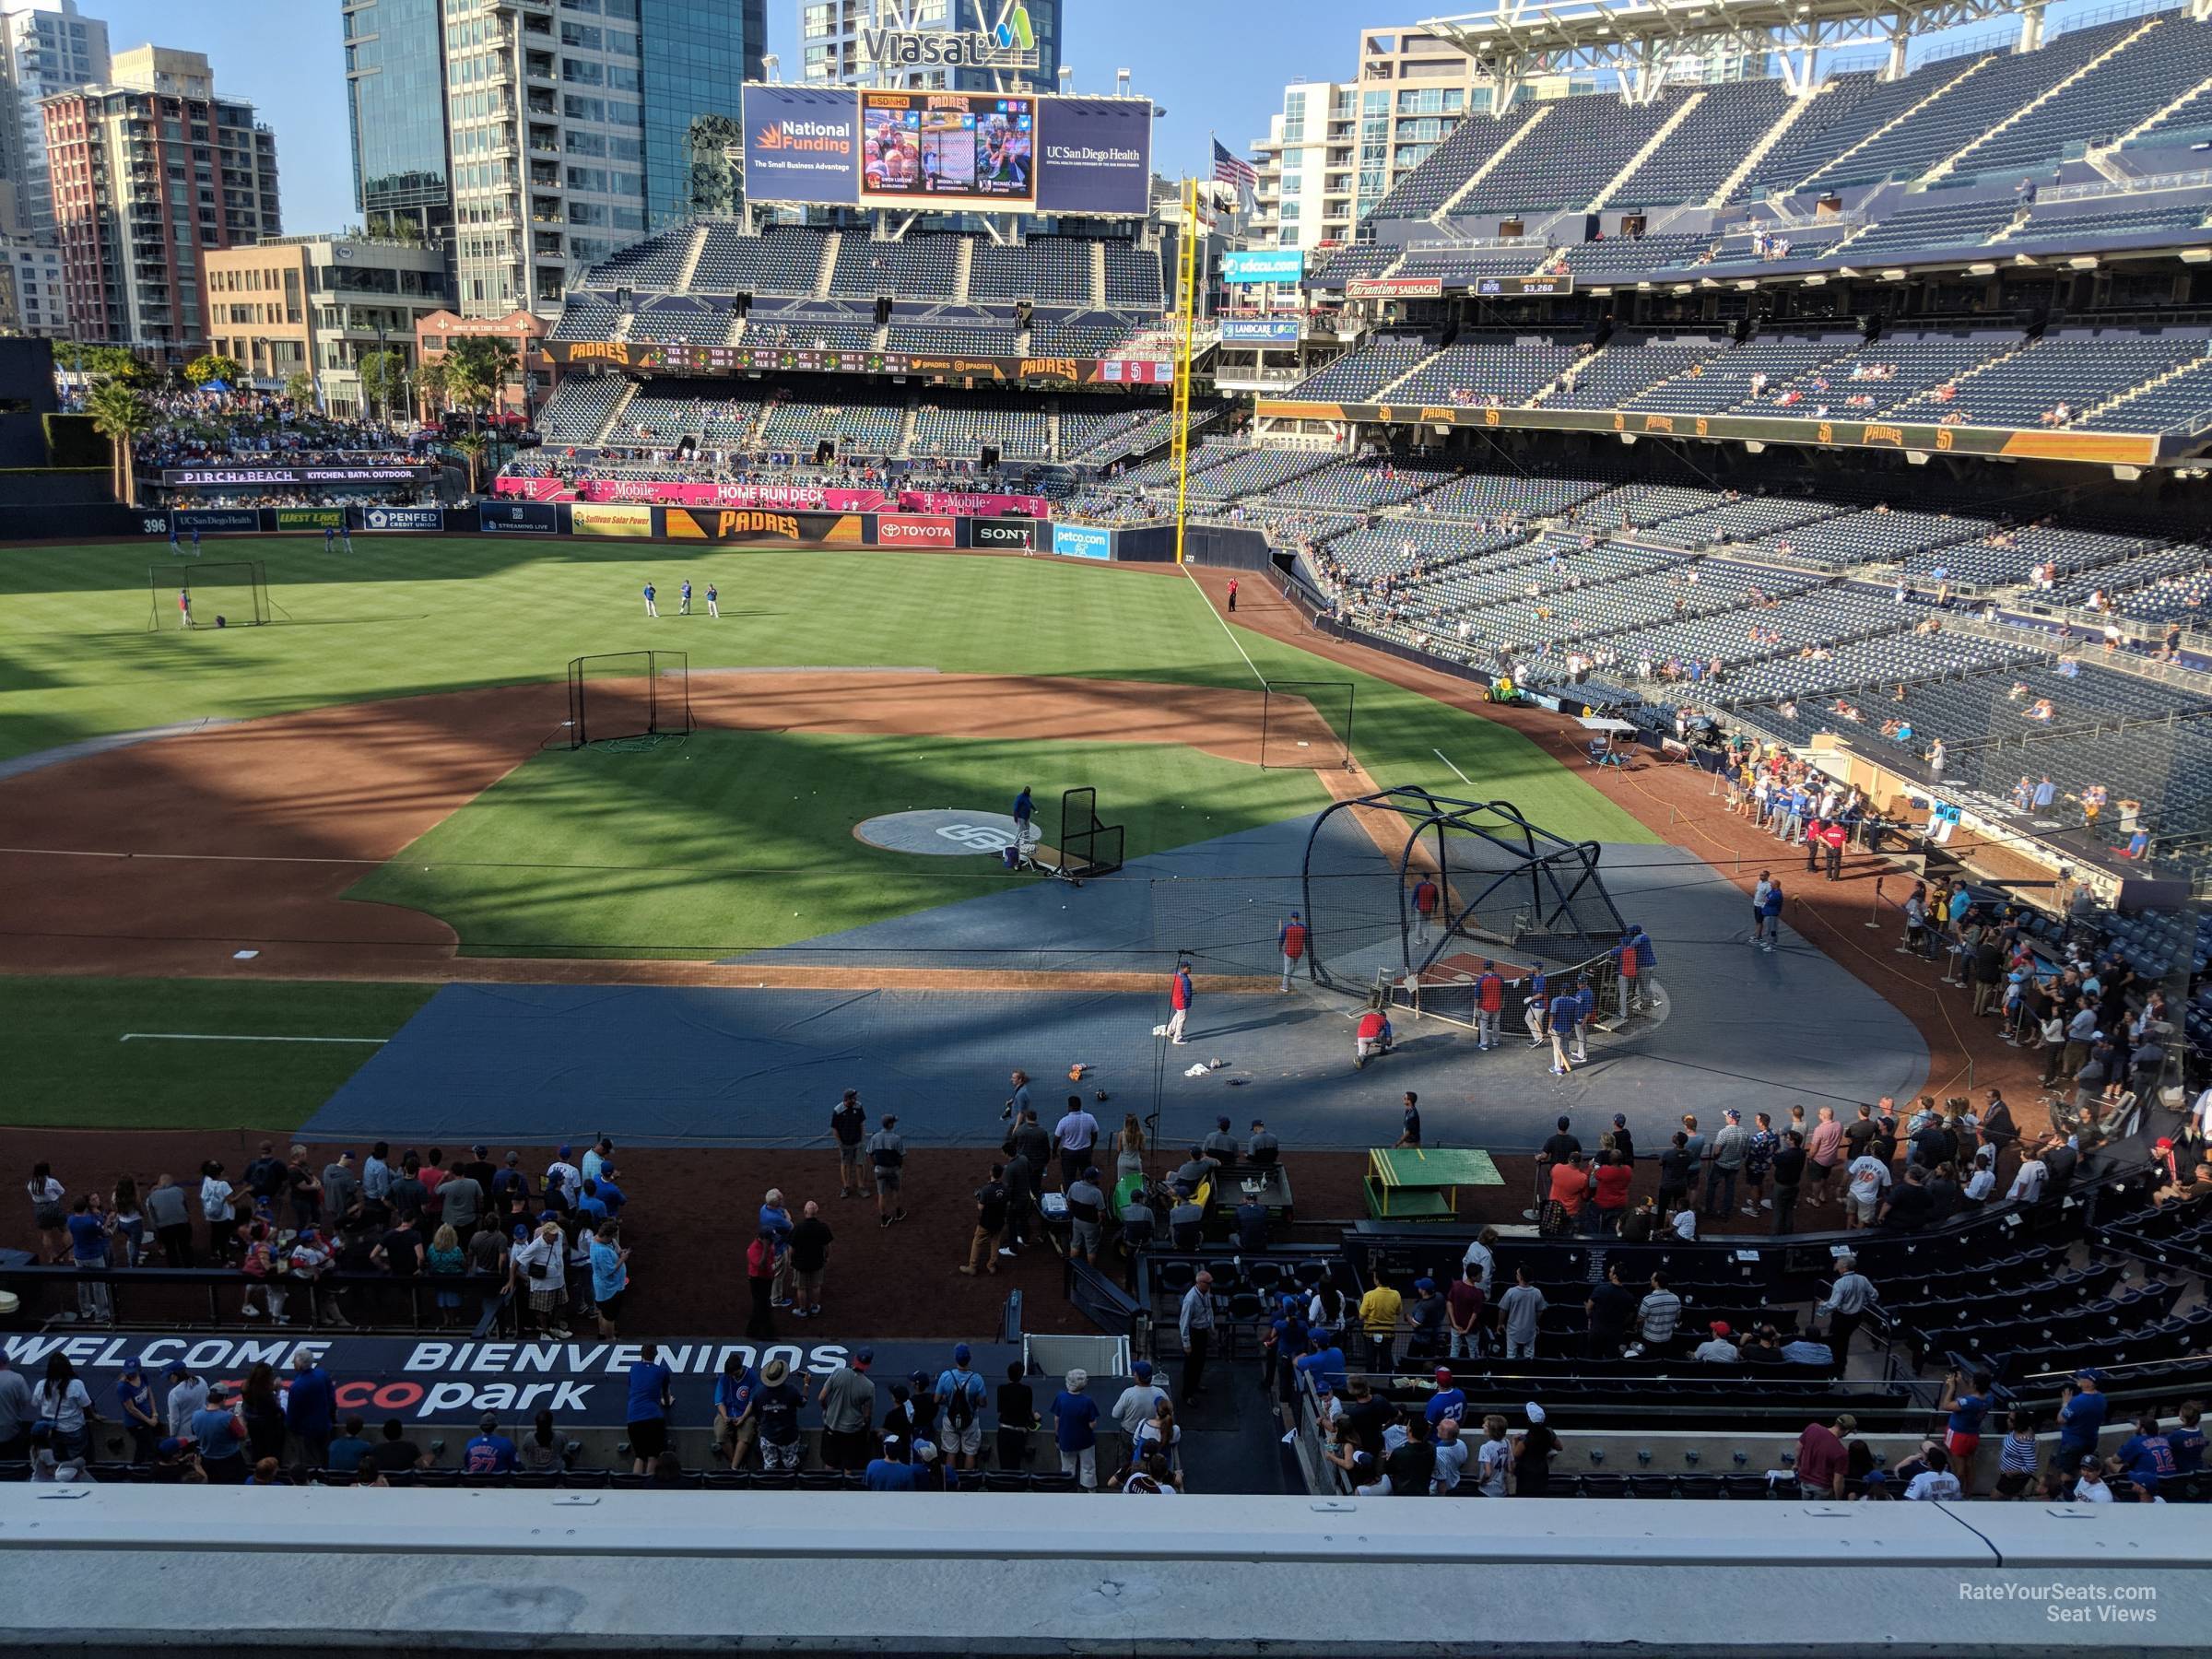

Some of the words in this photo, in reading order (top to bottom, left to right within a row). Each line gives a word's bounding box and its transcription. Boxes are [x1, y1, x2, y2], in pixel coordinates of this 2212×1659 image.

[863, 28, 984, 65] Viasat
[927, 96, 969, 112] PADRES
[782, 121, 850, 137] National
[782, 136, 850, 154] Funding
[1047, 147, 1062, 159] UC
[1063, 147, 1081, 159] San
[1082, 147, 1109, 161] Diego
[1110, 148, 1139, 160] Health
[768, 160, 785, 169] Small
[787, 161, 816, 170] Business
[818, 162, 850, 172] Advantage
[1241, 259, 1299, 272] sdccu.com
[1348, 281, 1398, 296] Tarantino
[1398, 284, 1439, 295] SAUSAGES
[1524, 284, 1554, 292] $3,260
[1235, 324, 1271, 333] LANDCARE
[1274, 324, 1297, 334] LOGIC
[570, 343, 629, 365] PADRES
[921, 361, 950, 370] @PADRES
[1020, 359, 1077, 381] PADRES
[1420, 406, 1455, 423] PADRES
[1645, 415, 1673, 432] PADRES
[1863, 426, 1902, 446] PADRES
[184, 473, 240, 482] PIRCH
[247, 471, 293, 481] BEACH
[719, 487, 758, 500] HOME
[759, 488, 787, 501] RUN
[791, 488, 825, 502] DECK
[180, 516, 193, 524] UC
[193, 516, 206, 524] San
[207, 516, 228, 526] Diego
[229, 516, 251, 524] Health
[280, 512, 312, 523] WEST
[312, 512, 341, 523] LAKE
[390, 512, 437, 522] PENFED
[585, 514, 611, 525] Sullivan
[612, 515, 628, 525] Solar
[629, 517, 649, 525] Power
[144, 518, 167, 533] 396
[718, 511, 800, 540] PADRES
[900, 525, 951, 537] TOYOTA
[981, 528, 1030, 540] SONY
[1058, 530, 1105, 545] petco.com
[4, 1335, 333, 1370] WELCOME
[403, 1342, 850, 1374] BIENVENIDOS
[1444, 1402, 1464, 1420] 23
[470, 1456, 496, 1474] 27
[2152, 1448, 2176, 1472] 12
